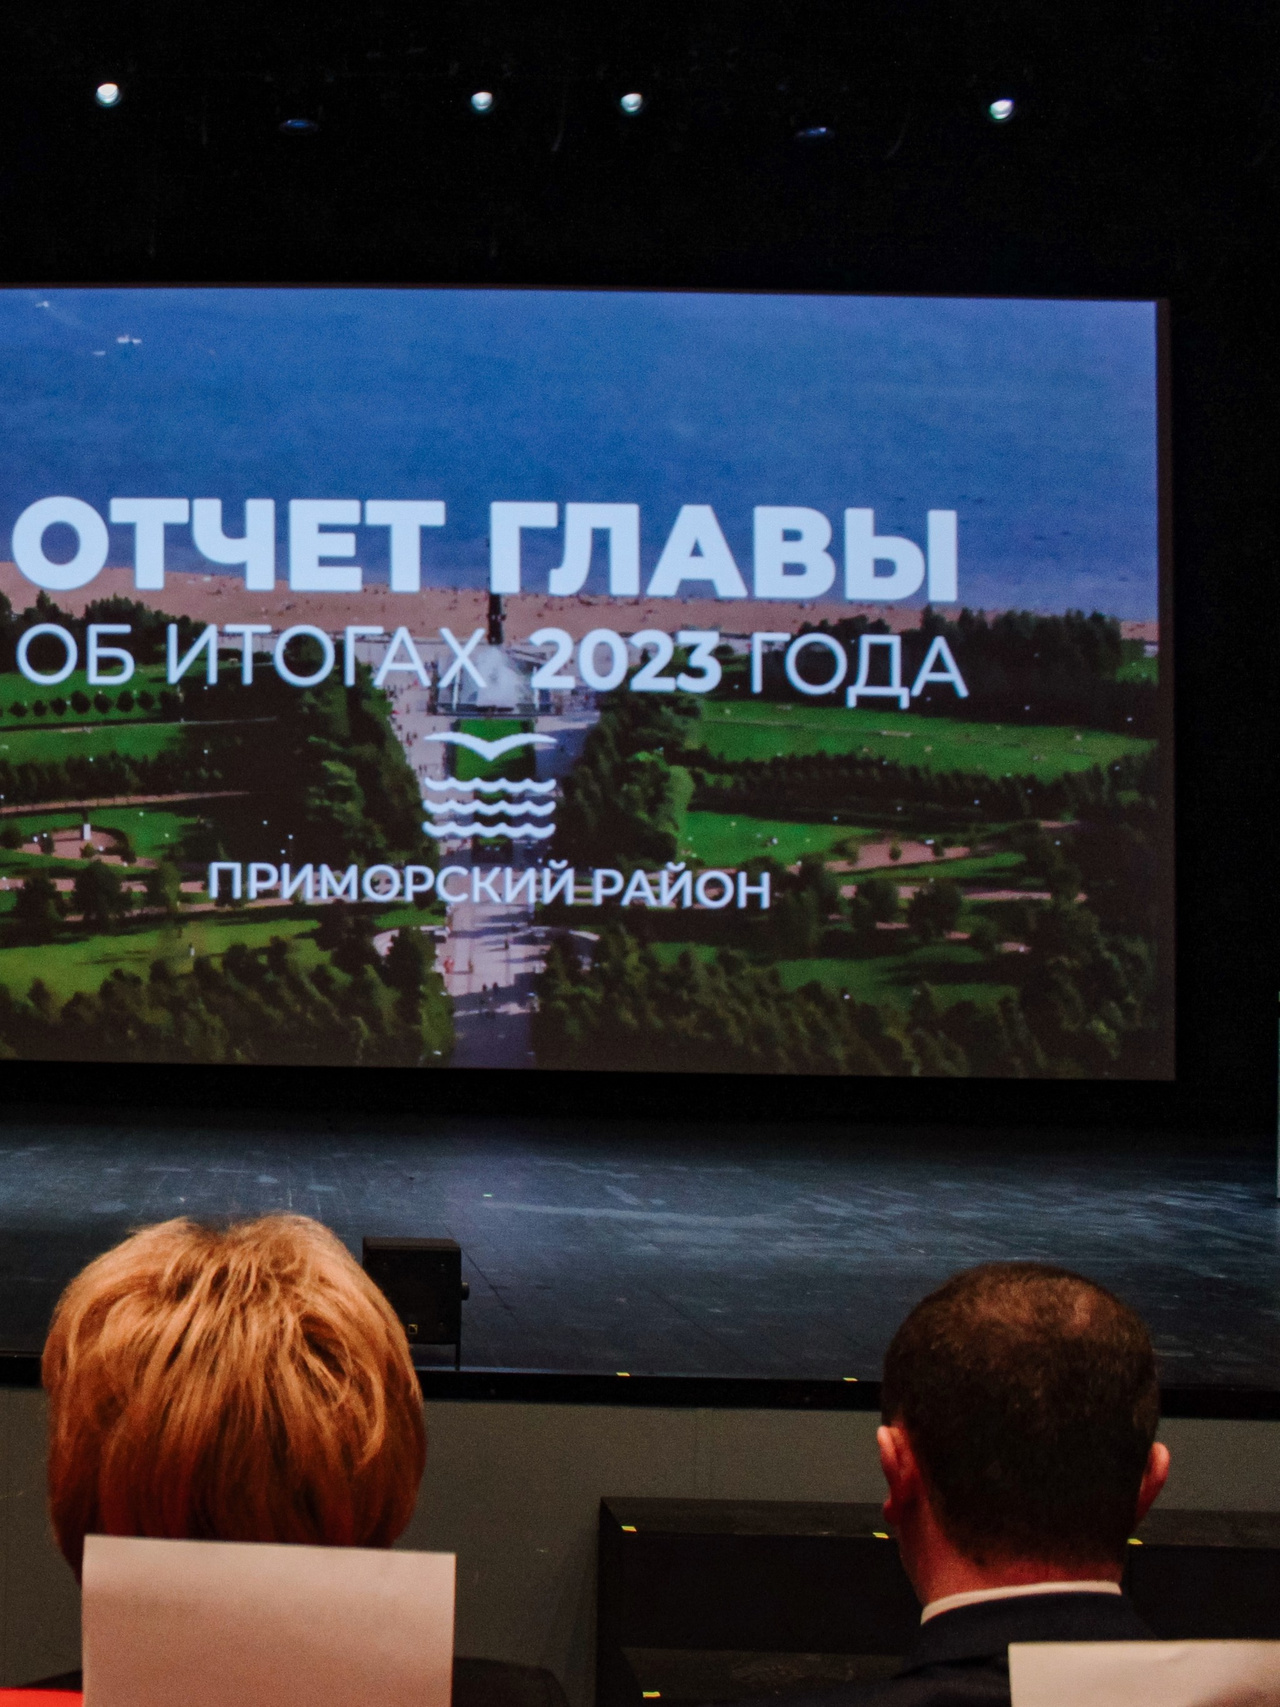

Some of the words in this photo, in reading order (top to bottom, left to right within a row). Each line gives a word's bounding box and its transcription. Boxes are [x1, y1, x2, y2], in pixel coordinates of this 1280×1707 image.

[12, 496, 446, 594] ОТЧЕТ
[490, 501, 958, 603] ГЛАВЫ
[16, 623, 135, 686] ОБ
[166, 623, 488, 691] ИТОГАХ
[529, 626, 723, 693] 2023
[750, 631, 970, 709] ГОДА
[208, 859, 576, 906] ПРИМОРСКИЙ
[593, 861, 772, 910] РАЙОН
